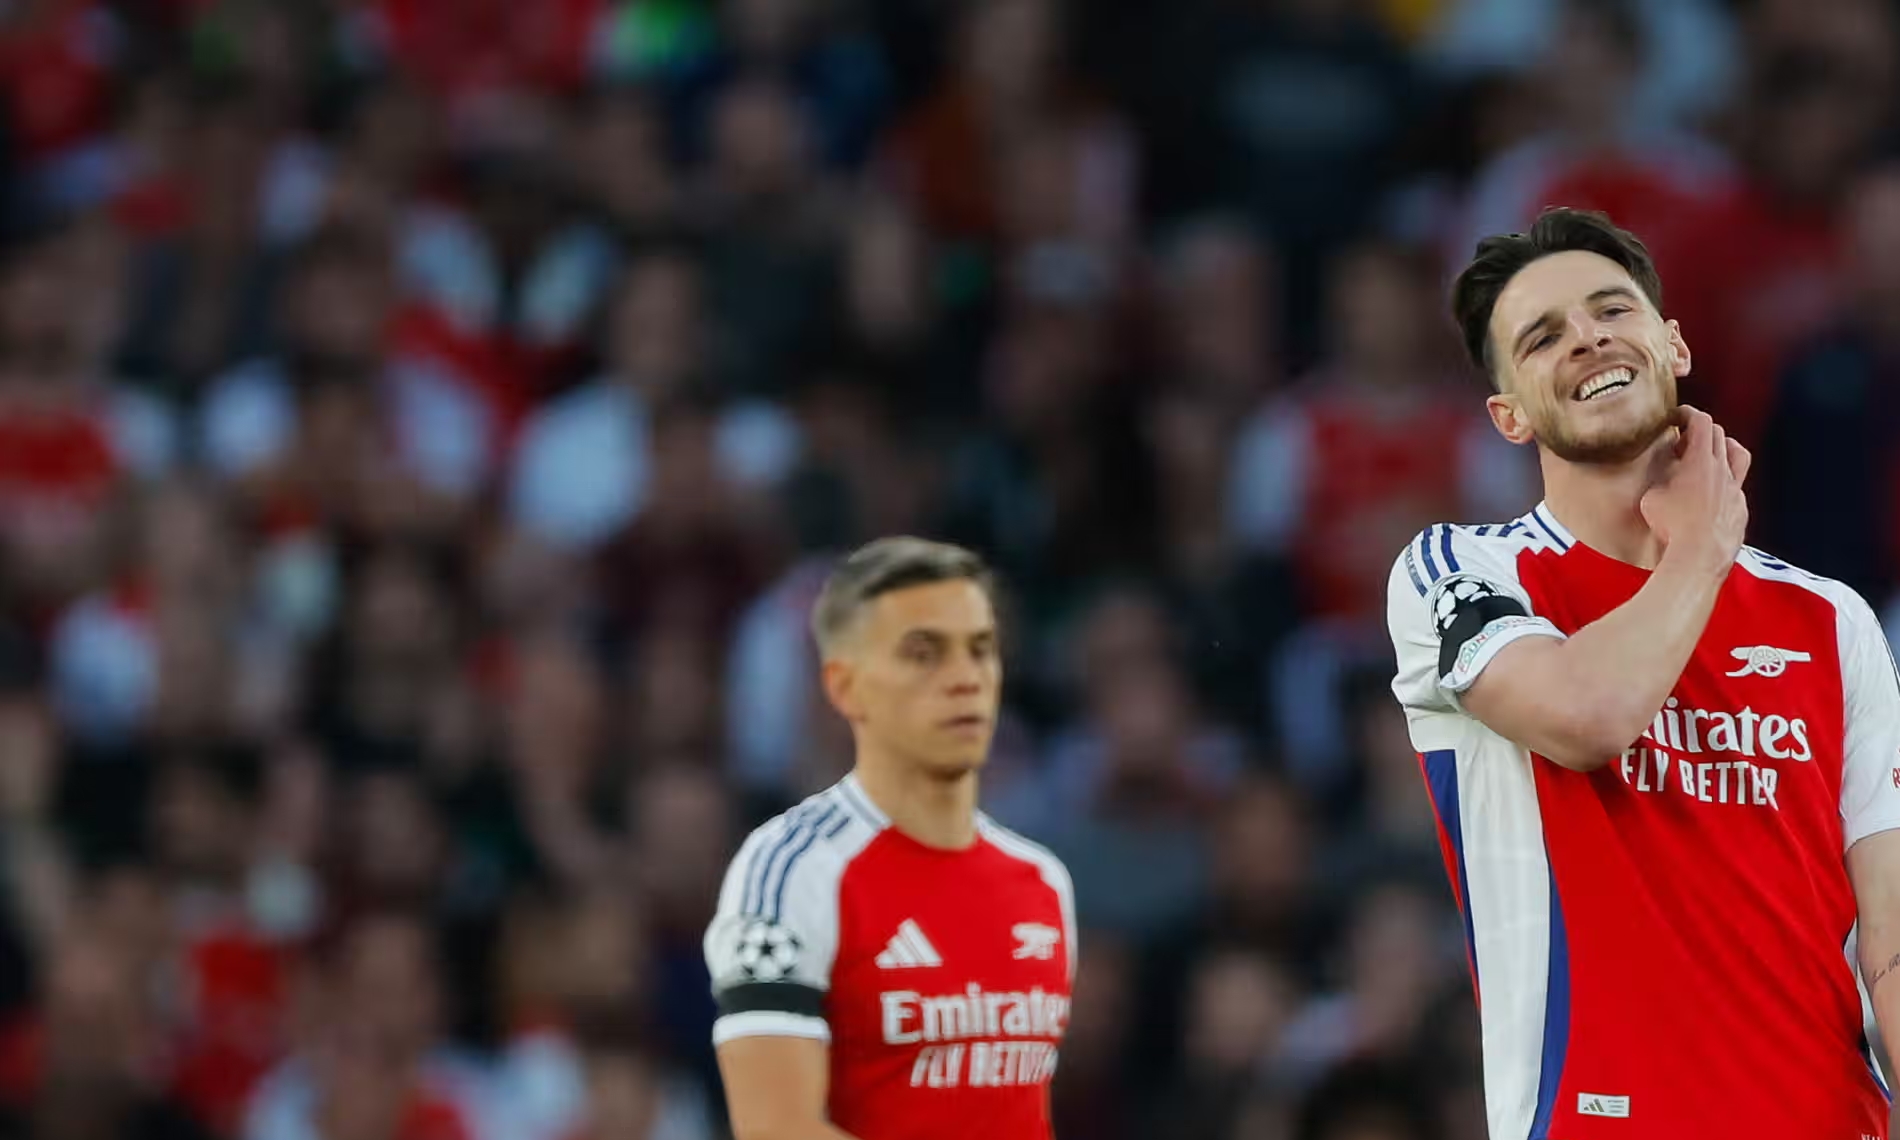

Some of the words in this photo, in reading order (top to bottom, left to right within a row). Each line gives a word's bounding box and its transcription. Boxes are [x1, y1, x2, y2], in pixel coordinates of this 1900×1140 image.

[1641, 697, 1812, 762] irates
[1620, 747, 1669, 792] FLY
[1679, 758, 1779, 811] BETTER
